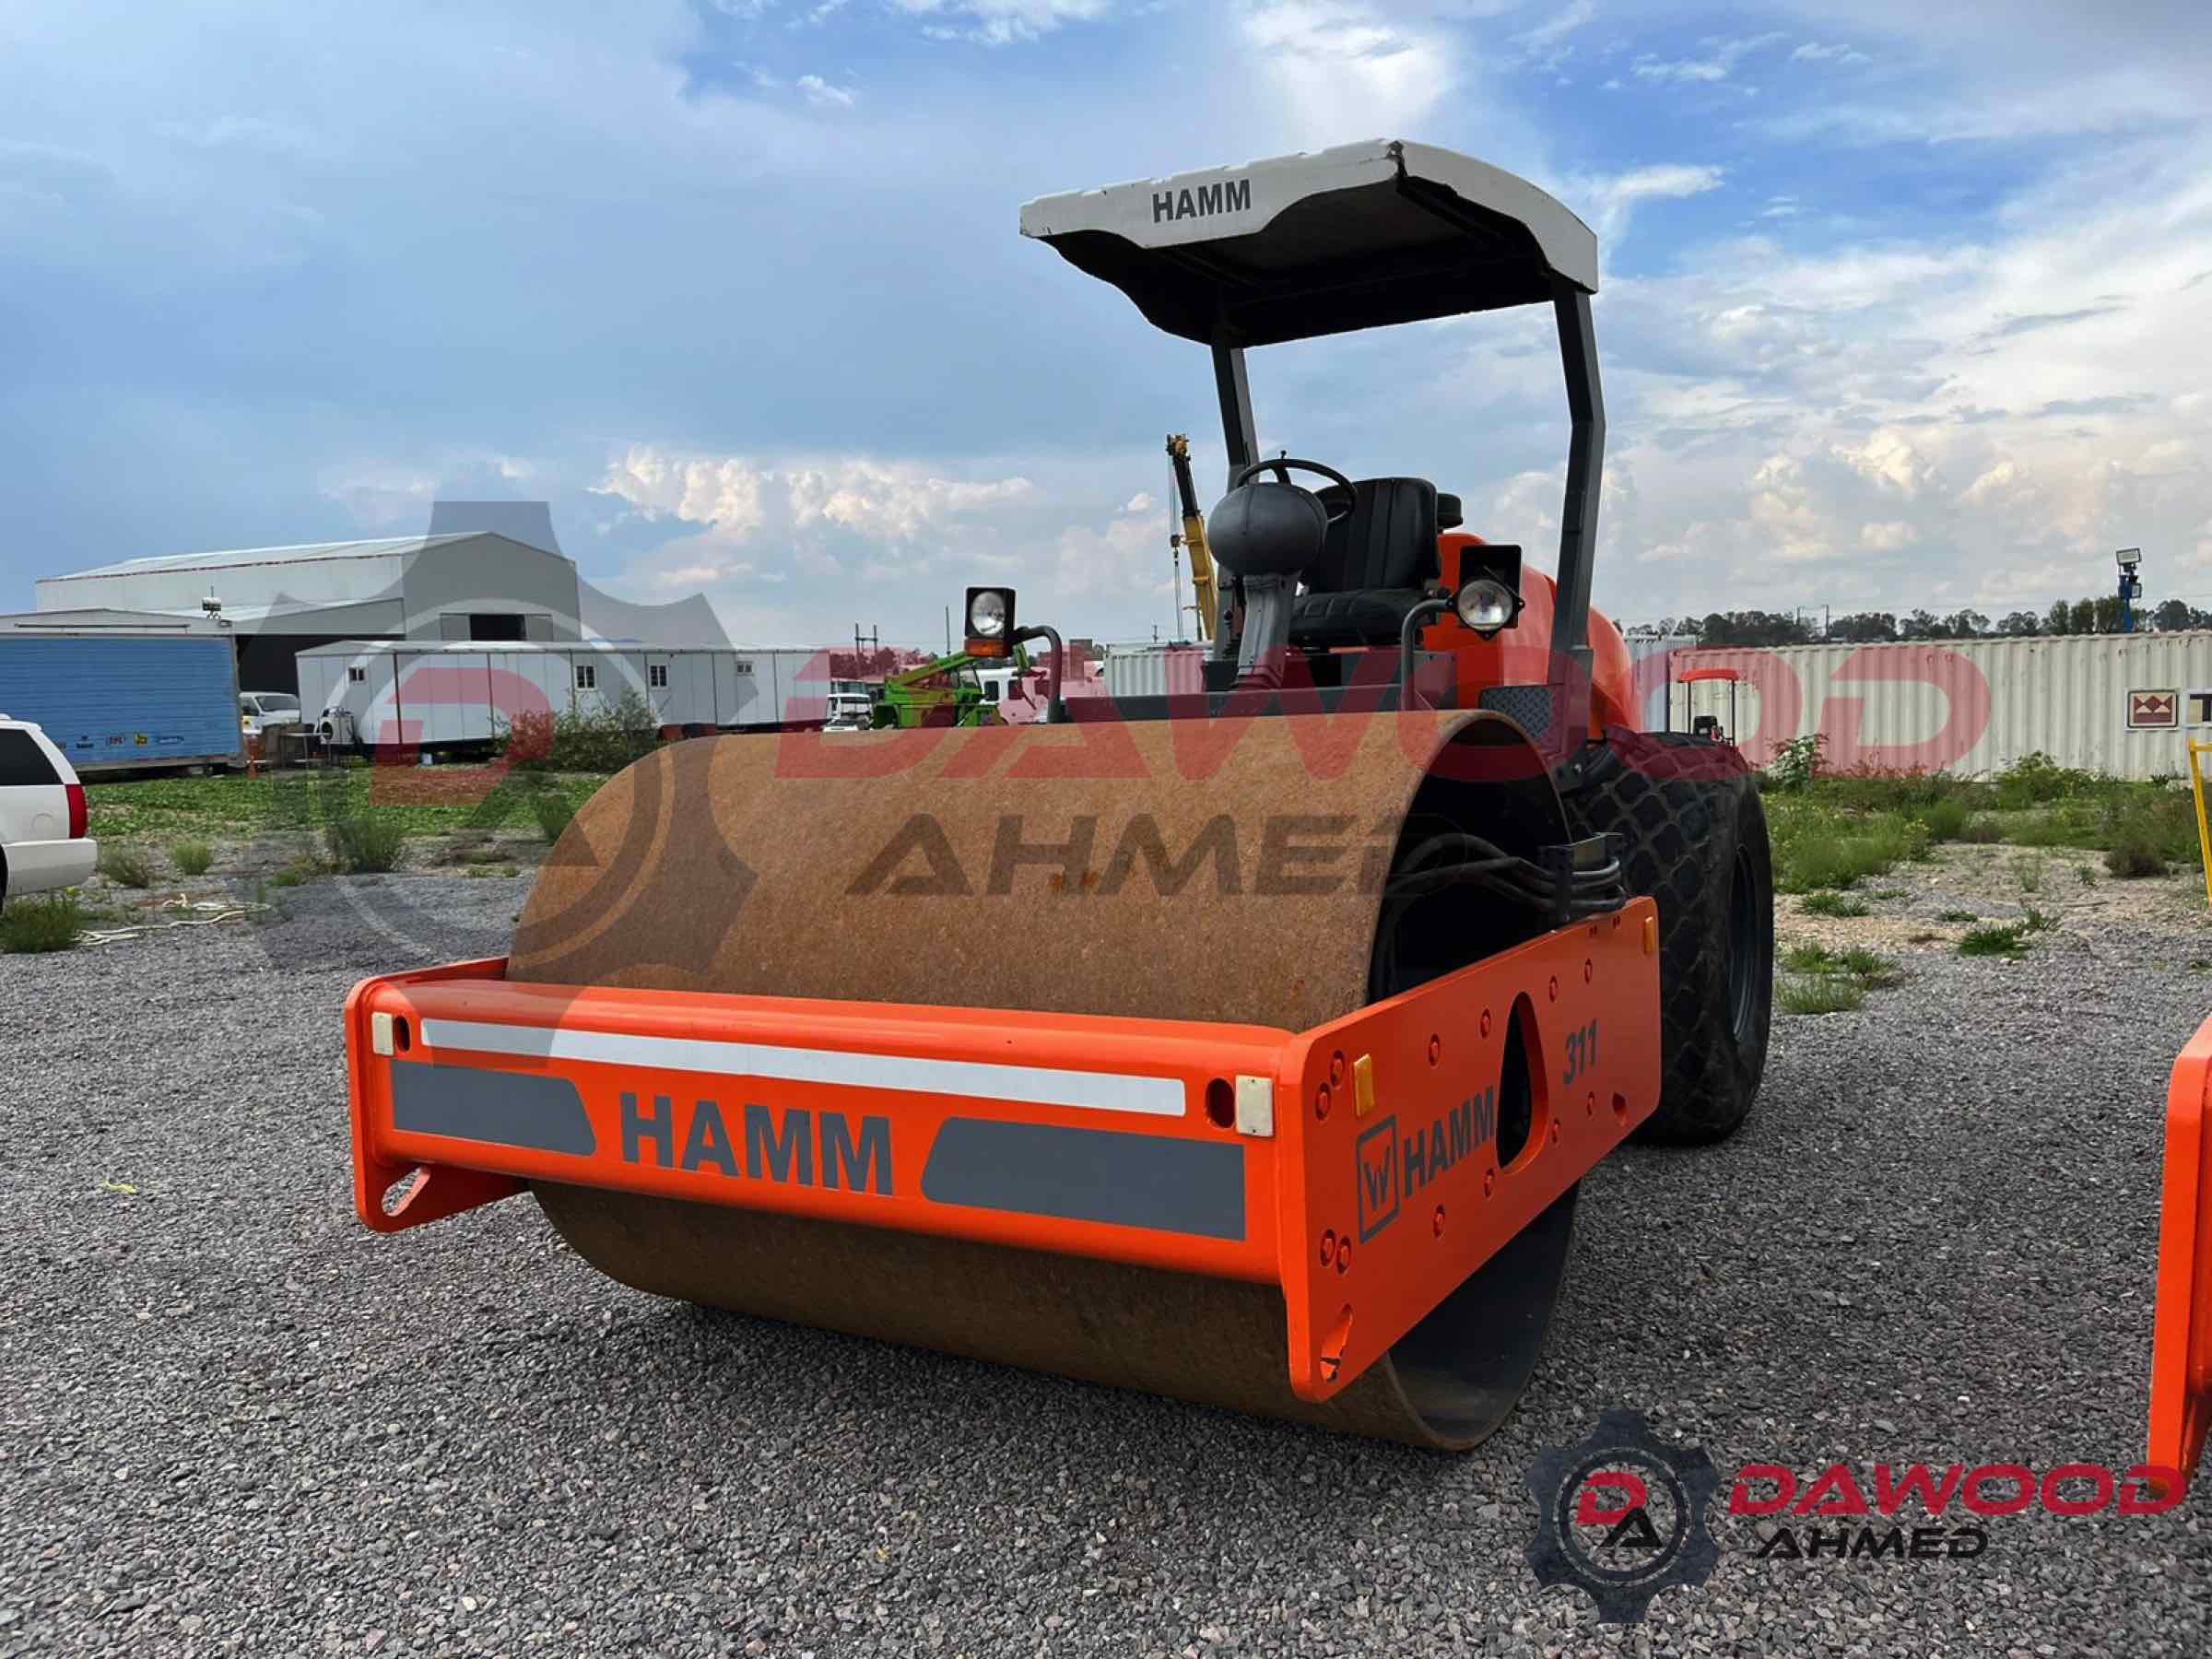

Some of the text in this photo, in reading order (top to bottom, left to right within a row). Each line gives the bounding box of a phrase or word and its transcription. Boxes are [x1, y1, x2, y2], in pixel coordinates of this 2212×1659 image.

[1152, 179, 1251, 223] HAMM
[1563, 1018, 1597, 1085] 311
[619, 1091, 893, 1196] HAMM
[1404, 1085, 1494, 1197] HAMM
